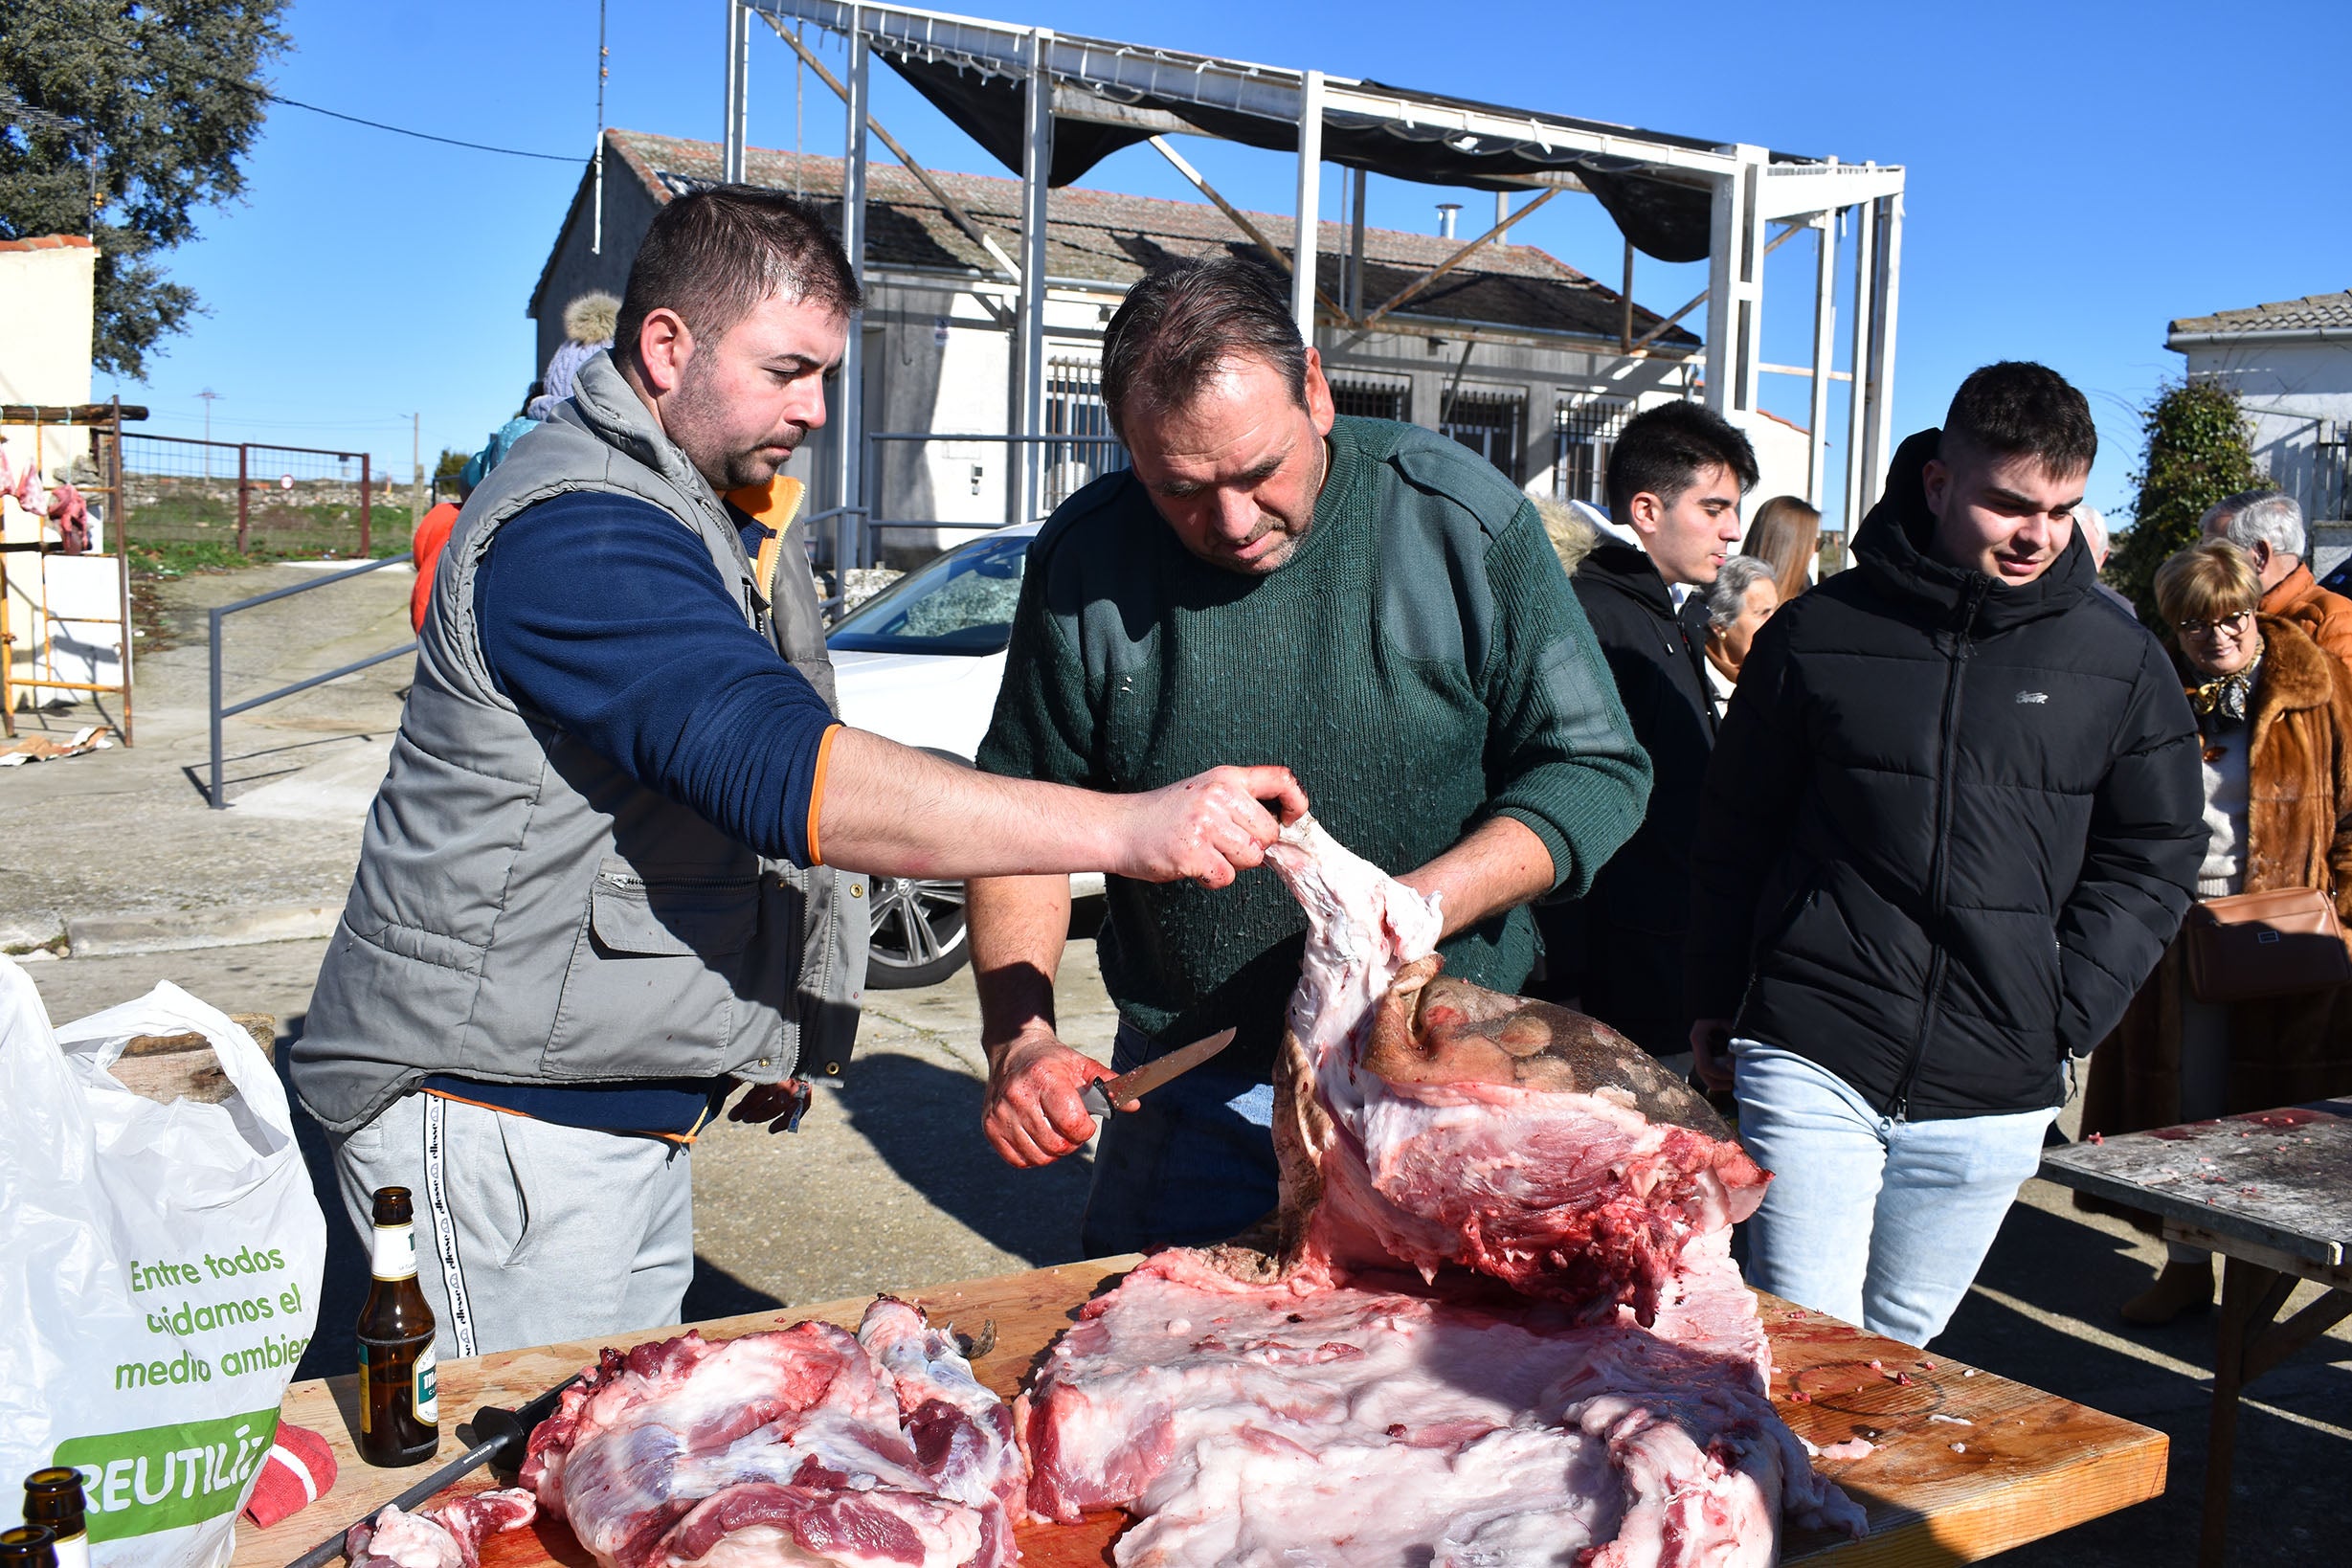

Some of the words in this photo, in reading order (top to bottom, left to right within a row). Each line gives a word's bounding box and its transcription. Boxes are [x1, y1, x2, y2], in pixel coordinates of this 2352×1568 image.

[430, 1123, 438, 1159] ellesse
[433, 1179, 445, 1215] ellesse
[130, 1260, 202, 1292] Entre
[204, 1245, 285, 1279] todos
[444, 1234, 456, 1269] ellesse
[280, 1283, 302, 1314] el
[455, 1289, 466, 1325] ellesse
[115, 1349, 213, 1390] medio
